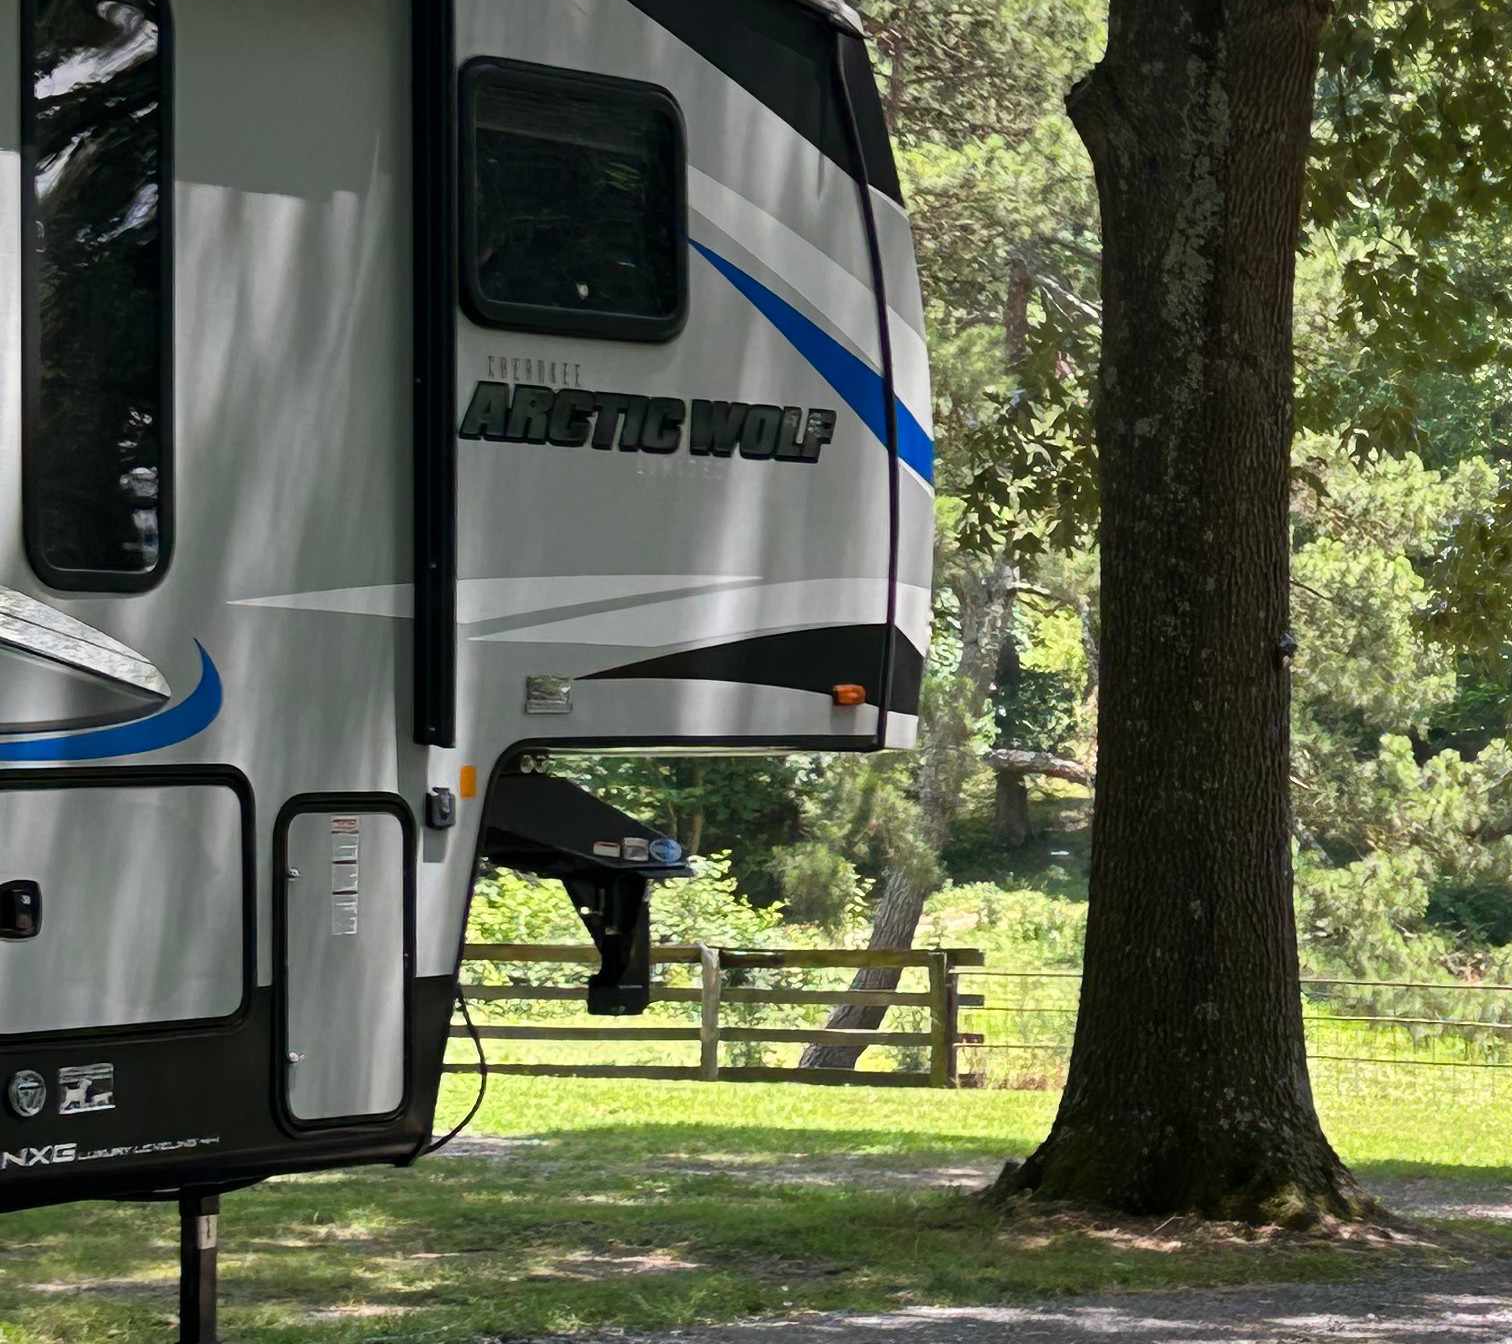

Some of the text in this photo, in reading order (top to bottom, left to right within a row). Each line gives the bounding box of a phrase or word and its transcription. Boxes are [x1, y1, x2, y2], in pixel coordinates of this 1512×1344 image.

[459, 380, 838, 464] ARCTIC WOLF
[0, 1142, 77, 1169] NXG
